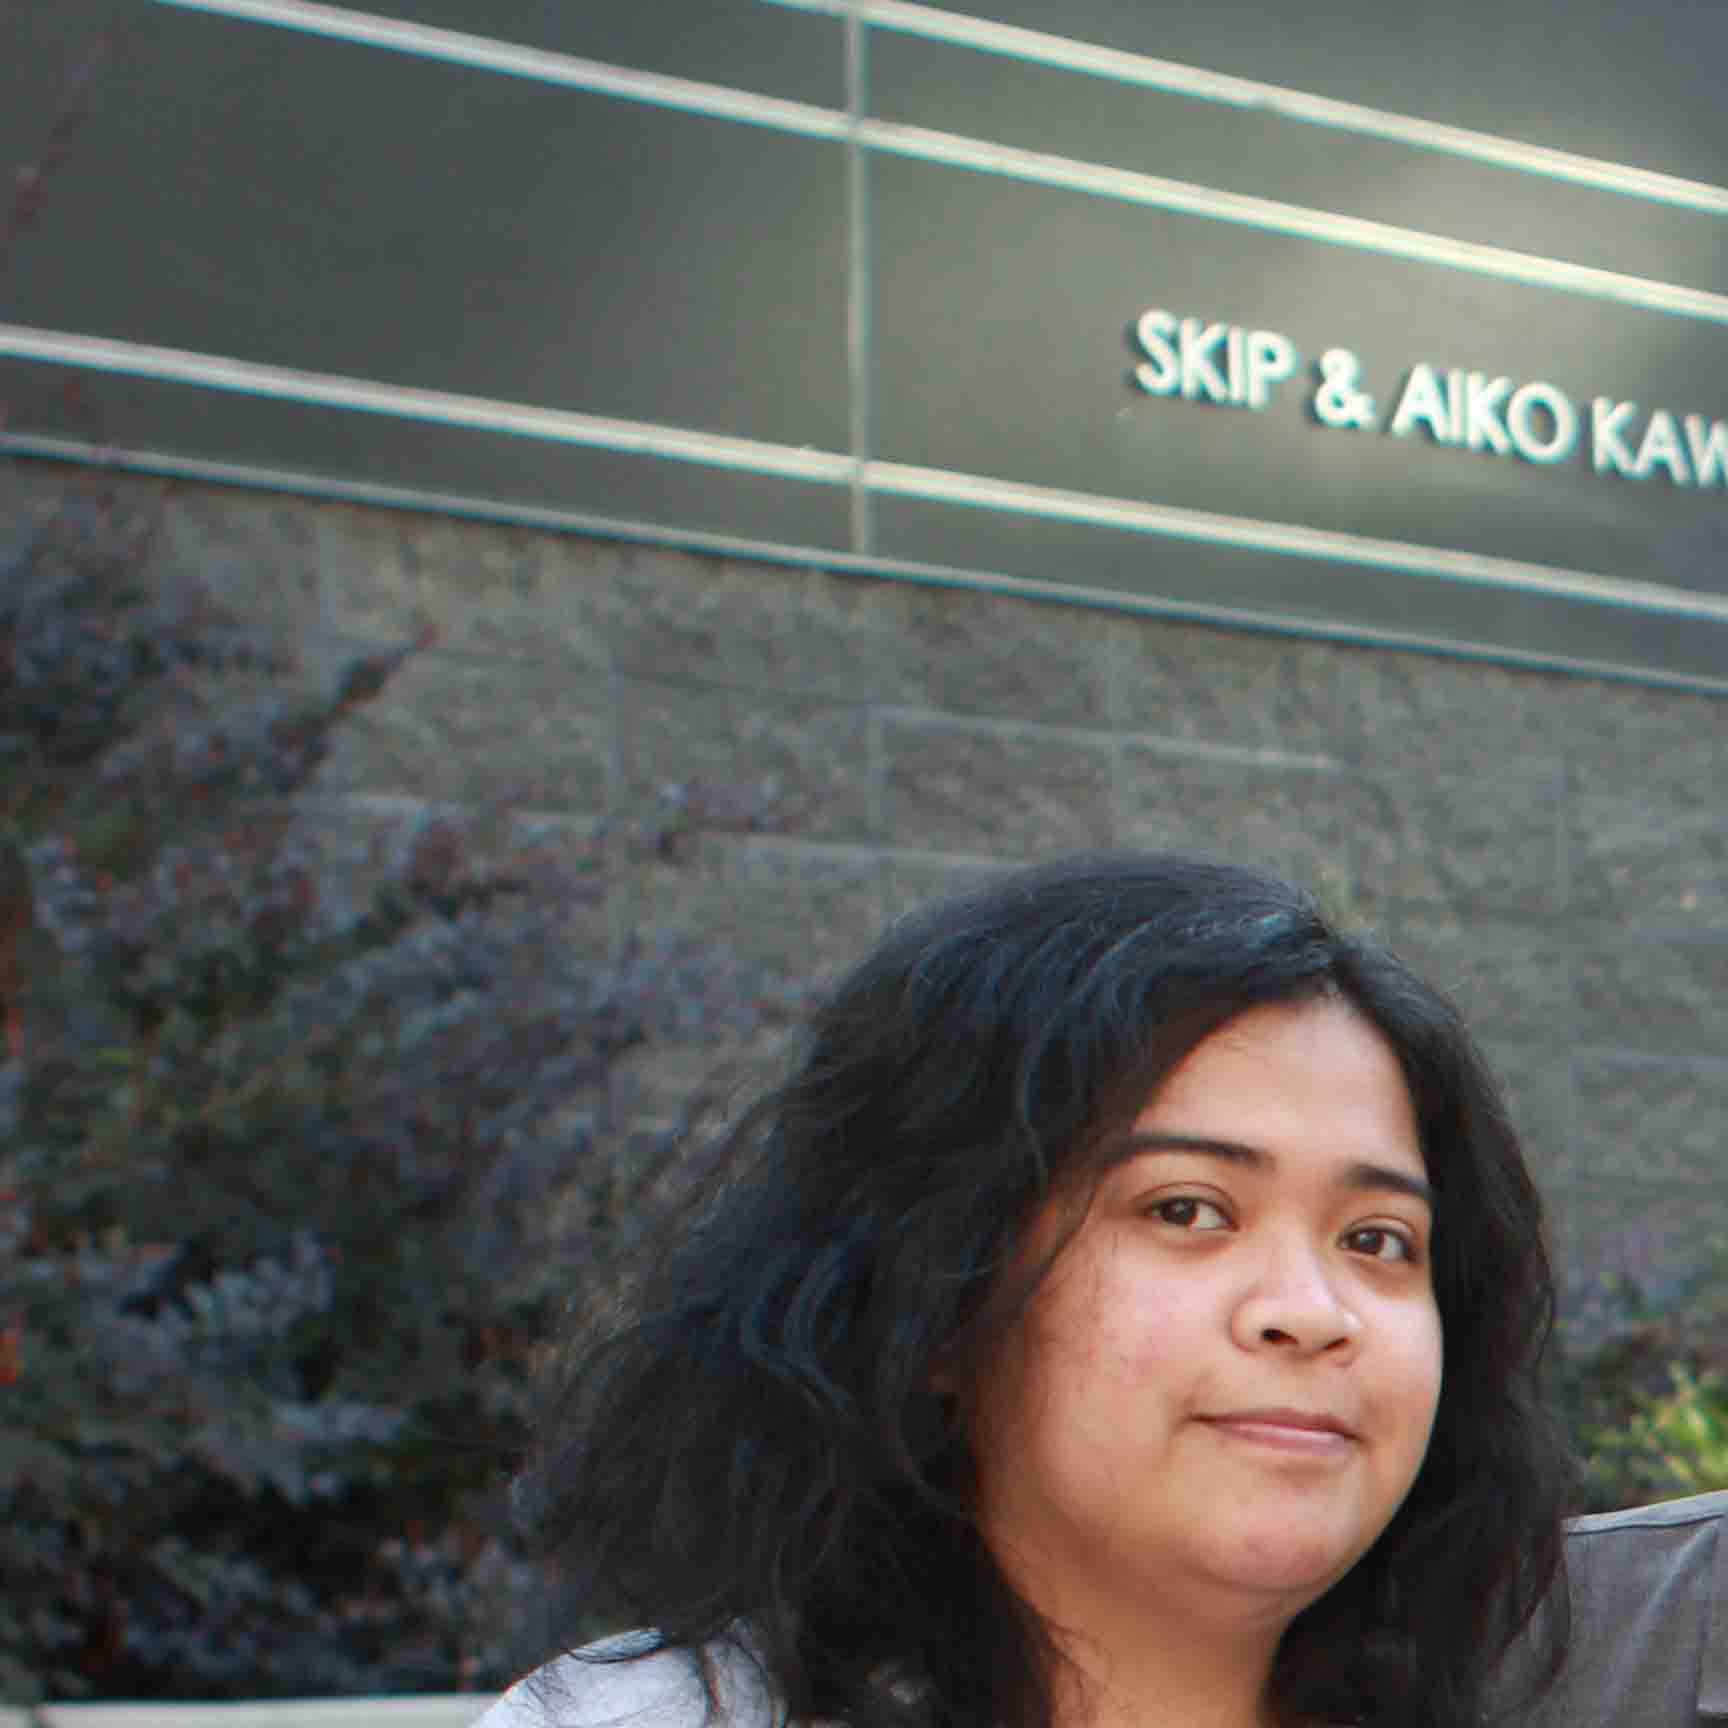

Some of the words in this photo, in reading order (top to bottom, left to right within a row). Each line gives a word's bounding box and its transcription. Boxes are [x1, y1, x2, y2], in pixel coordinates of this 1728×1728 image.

[1136, 308, 1296, 409] SKIP
[1314, 347, 1374, 433] &
[1390, 363, 1575, 465] AIKO
